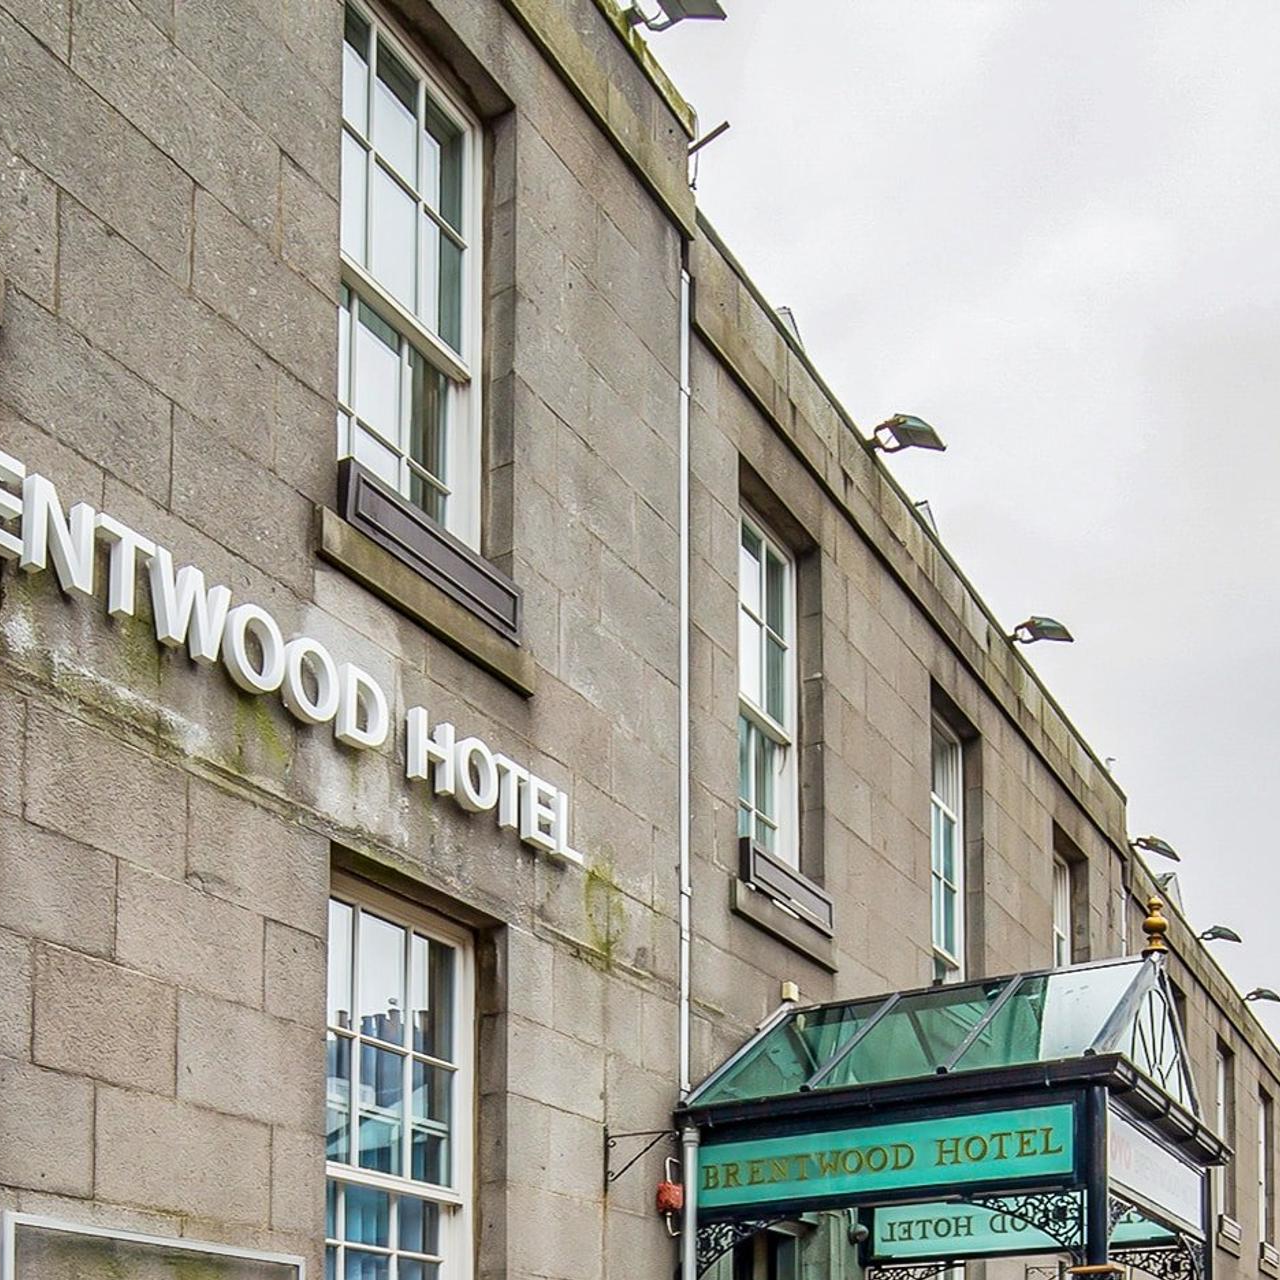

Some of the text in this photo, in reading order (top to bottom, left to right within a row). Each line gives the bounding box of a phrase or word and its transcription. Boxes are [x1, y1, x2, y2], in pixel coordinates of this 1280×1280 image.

[406, 706, 583, 866] HOTEL
[702, 1128, 1063, 1190] BRENTWOOD HOTEL
